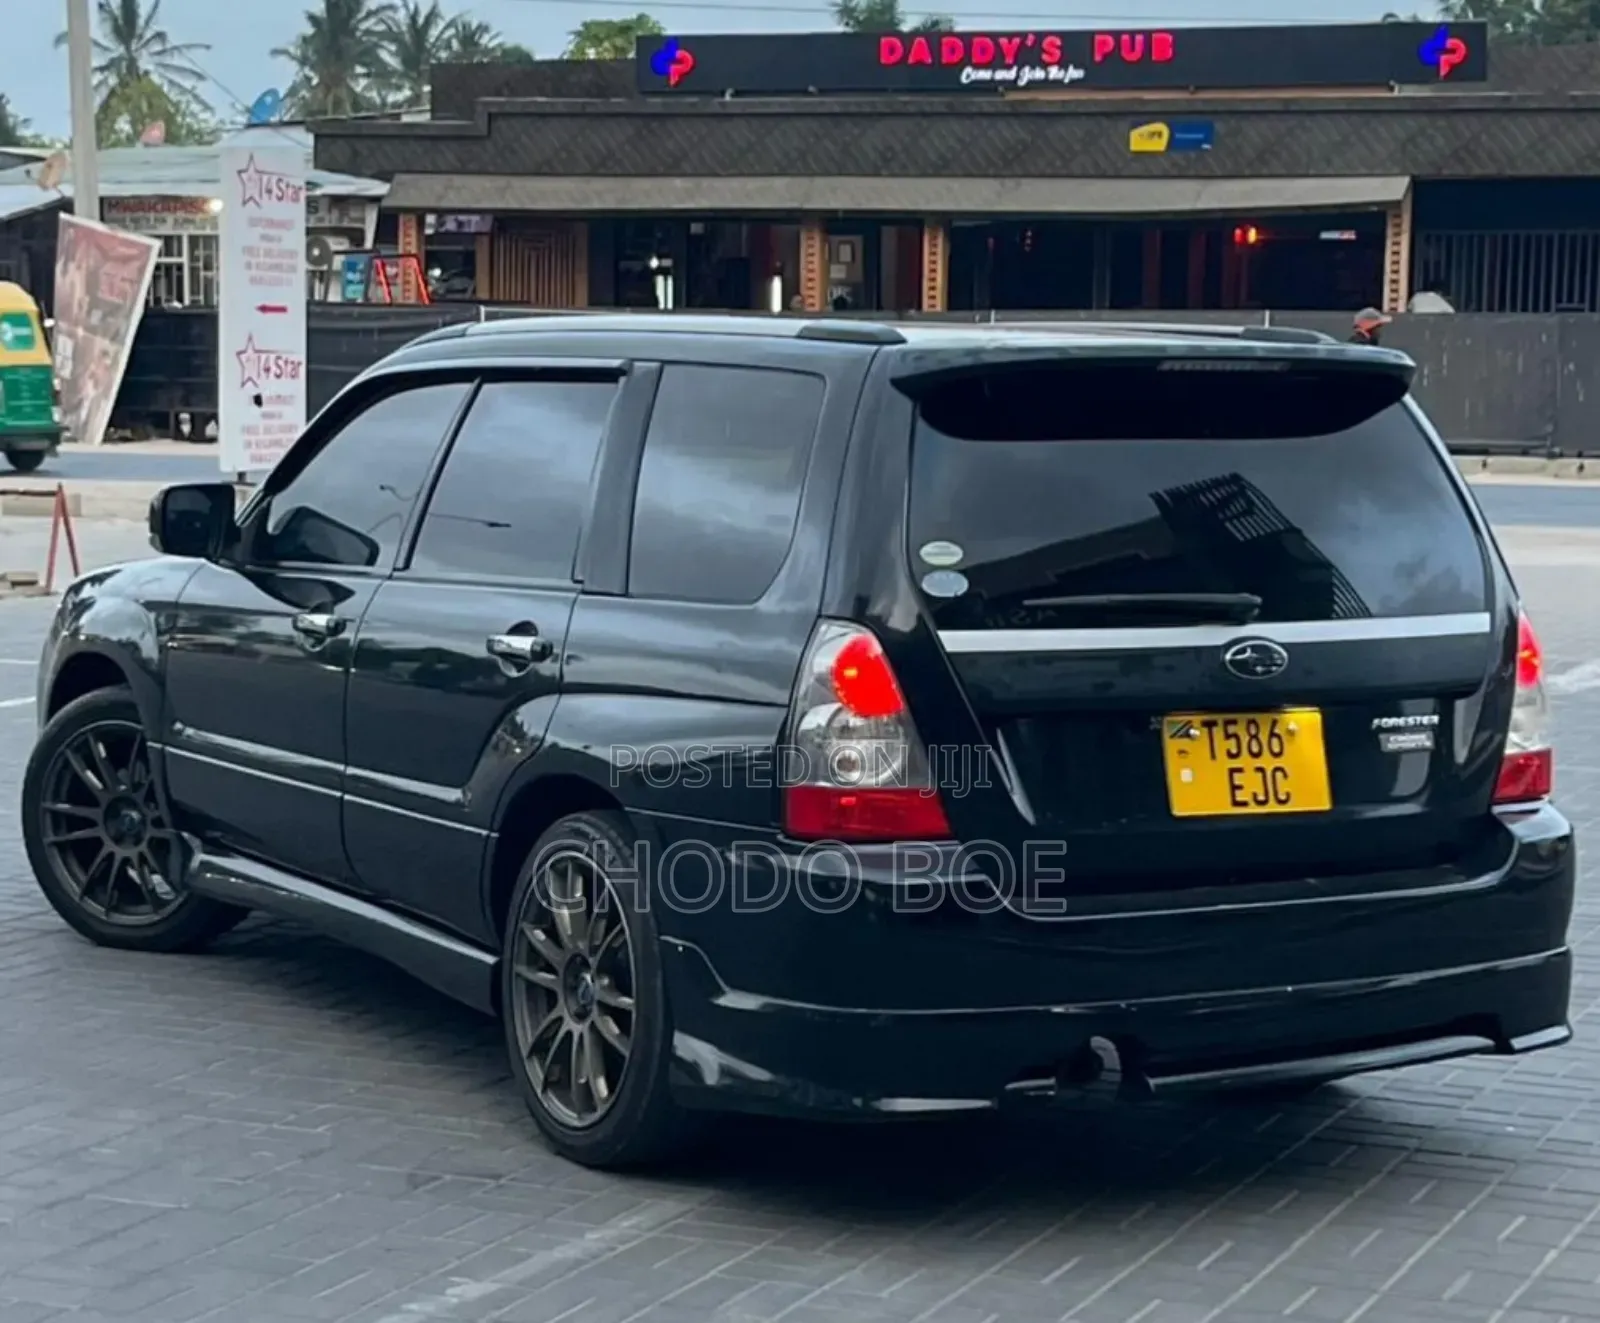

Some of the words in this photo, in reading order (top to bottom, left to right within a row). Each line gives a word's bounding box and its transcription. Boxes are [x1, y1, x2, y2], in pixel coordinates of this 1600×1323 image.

[880, 35, 1063, 65] DADDY'S
[1093, 32, 1174, 62] PUB
[994, 65, 1018, 80] and
[1202, 718, 1284, 760] T586
[1371, 714, 1440, 731] FORESTER
[1227, 766, 1292, 807] EJC
